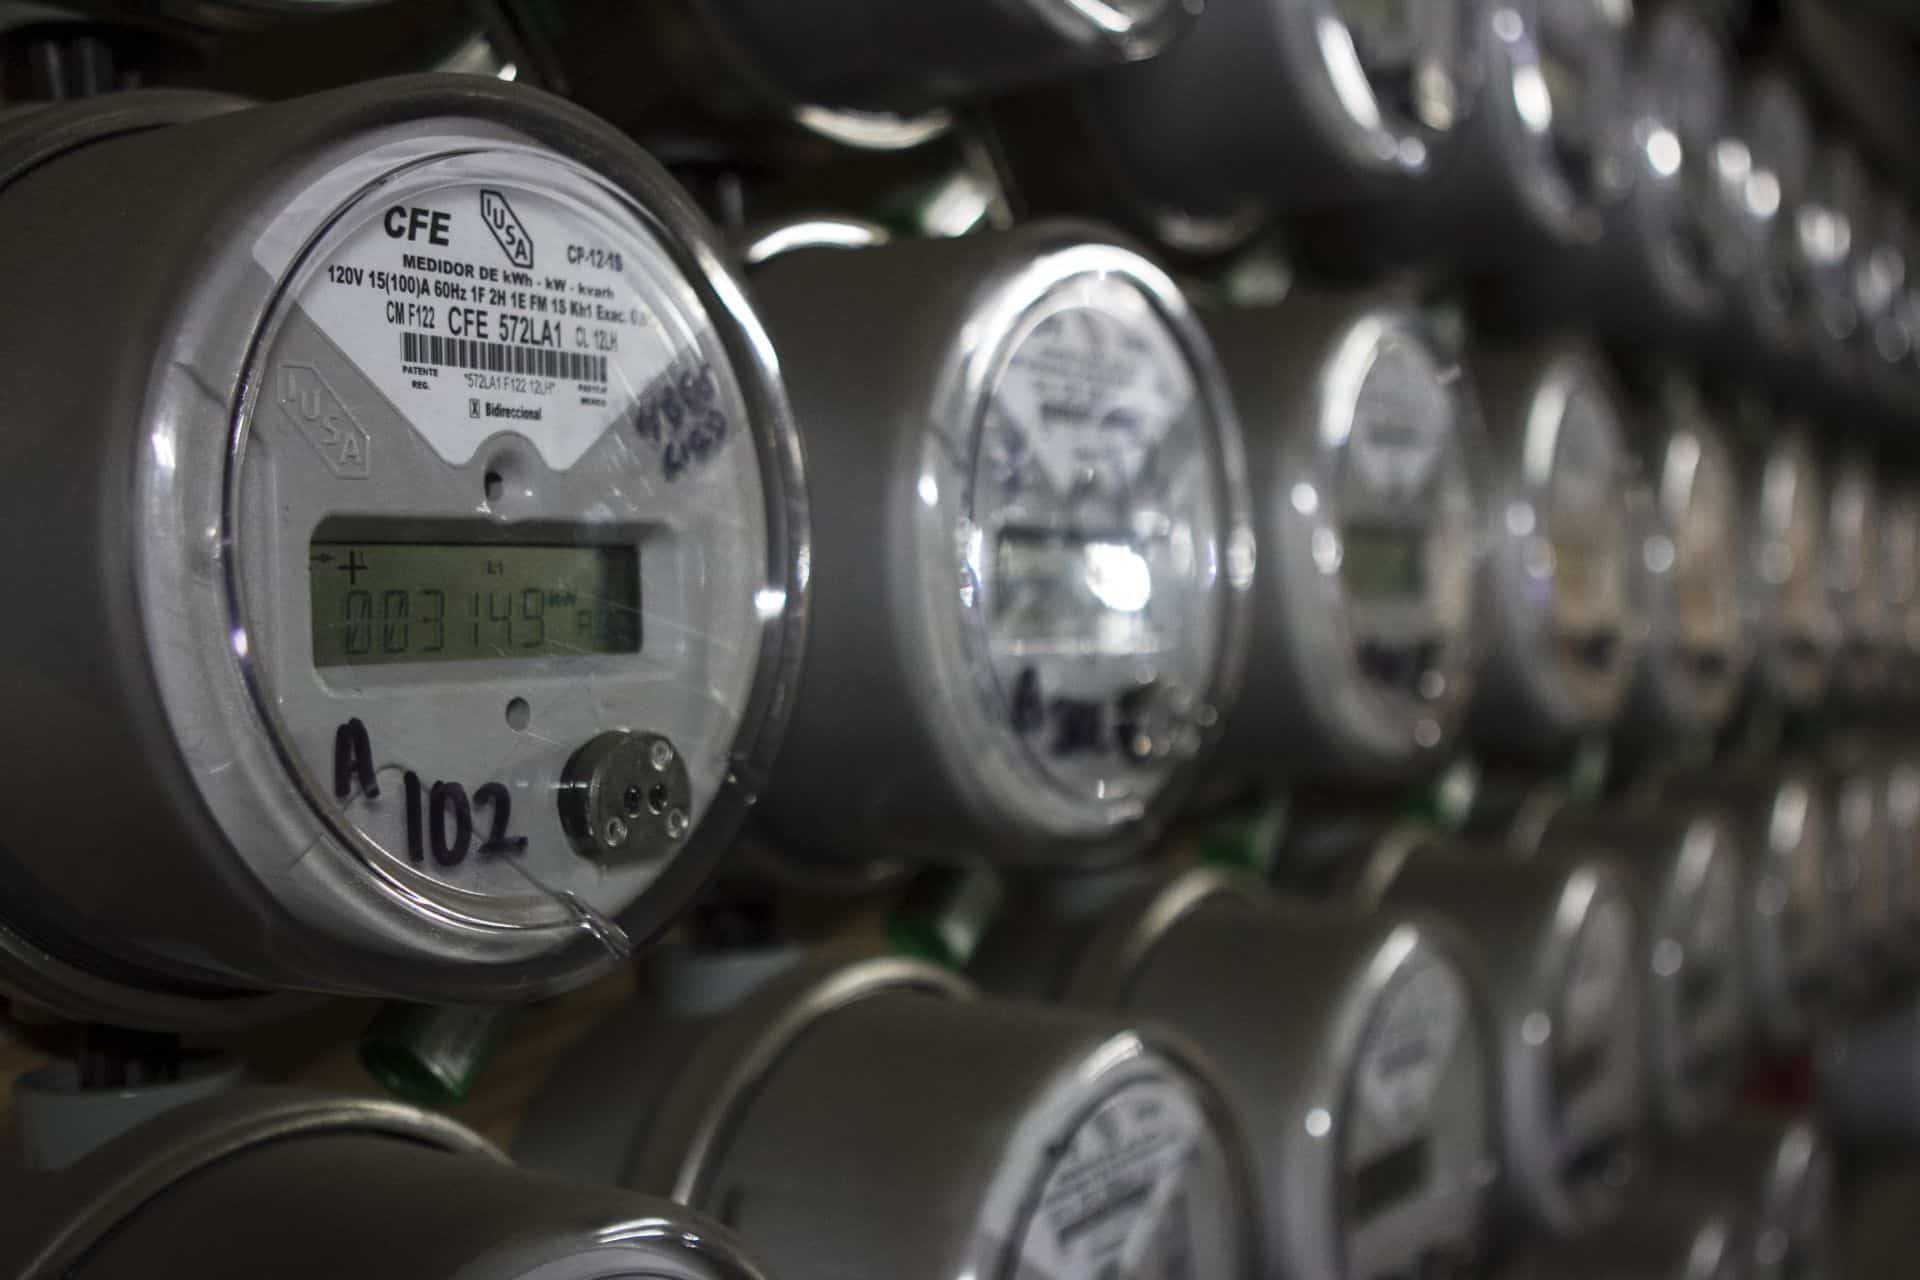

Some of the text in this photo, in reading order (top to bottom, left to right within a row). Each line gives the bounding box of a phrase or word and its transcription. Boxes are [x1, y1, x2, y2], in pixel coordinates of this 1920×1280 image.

[384, 205, 452, 246] CFE
[486, 198, 528, 261] IUSA
[328, 264, 364, 287] 120V
[369, 270, 430, 298] 15(100)A
[434, 280, 467, 301] 60Hz
[471, 286, 486, 303] 1F
[489, 288, 506, 306] 2H
[511, 291, 526, 309] 1E
[530, 294, 548, 313] FM
[403, 254, 474, 278] MEDIDOR
[479, 266, 498, 282] DE
[503, 270, 533, 287] kWh
[545, 277, 566, 292] kW
[578, 282, 614, 299] kvarh
[386, 301, 404, 325] CM
[408, 303, 435, 328] F122
[448, 306, 488, 339] CFE
[500, 314, 562, 348] 572LA1
[402, 365, 438, 377] PATENTE
[412, 380, 430, 390] REG.
[485, 402, 542, 420] Bidireccional
[346, 588, 545, 655] 003149
[335, 718, 380, 799] A
[403, 770, 528, 867] 102
